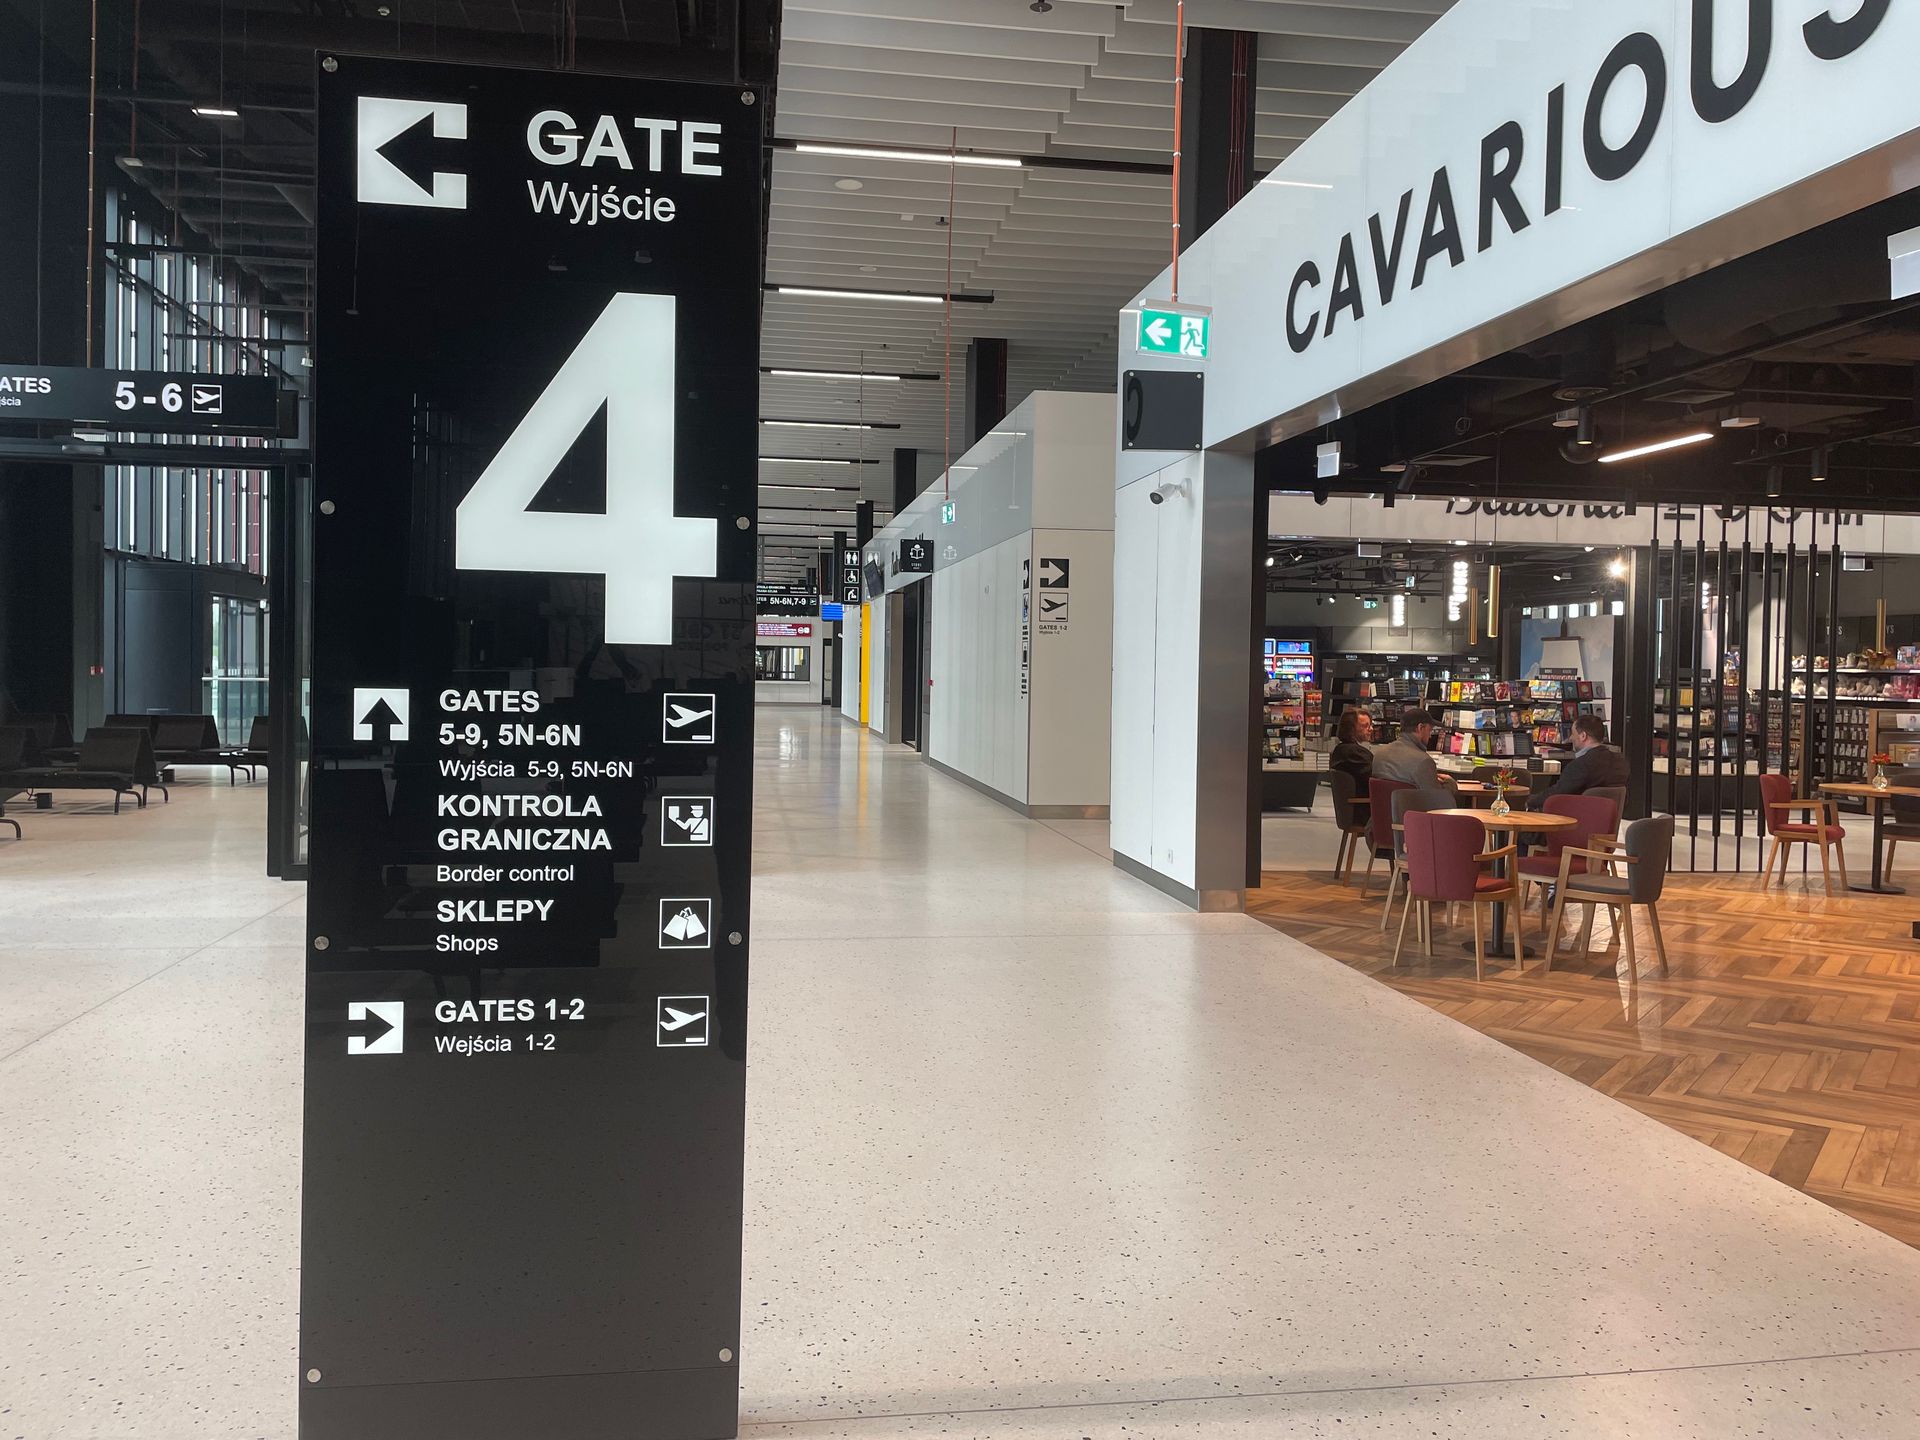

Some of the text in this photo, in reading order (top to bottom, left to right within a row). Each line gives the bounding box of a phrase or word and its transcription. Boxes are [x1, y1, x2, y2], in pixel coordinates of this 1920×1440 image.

[527, 110, 722, 176] GATE
[527, 180, 676, 225] Wyjście
[0, 375, 52, 394] ATES
[456, 292, 718, 646] 4
[439, 689, 540, 713] GATES
[438, 722, 581, 748] 5-9, 5N-6N
[439, 759, 633, 782] Wyjścia 5-9, 5N-6N
[438, 794, 603, 817] KONTROLA
[438, 828, 612, 851] GRANICZNA
[437, 864, 574, 882] Border control
[436, 899, 555, 923] SKLEPY
[436, 934, 499, 956] Shops
[434, 998, 585, 1023] GATES 1-2
[434, 1034, 556, 1057] Wejścia 1-2
